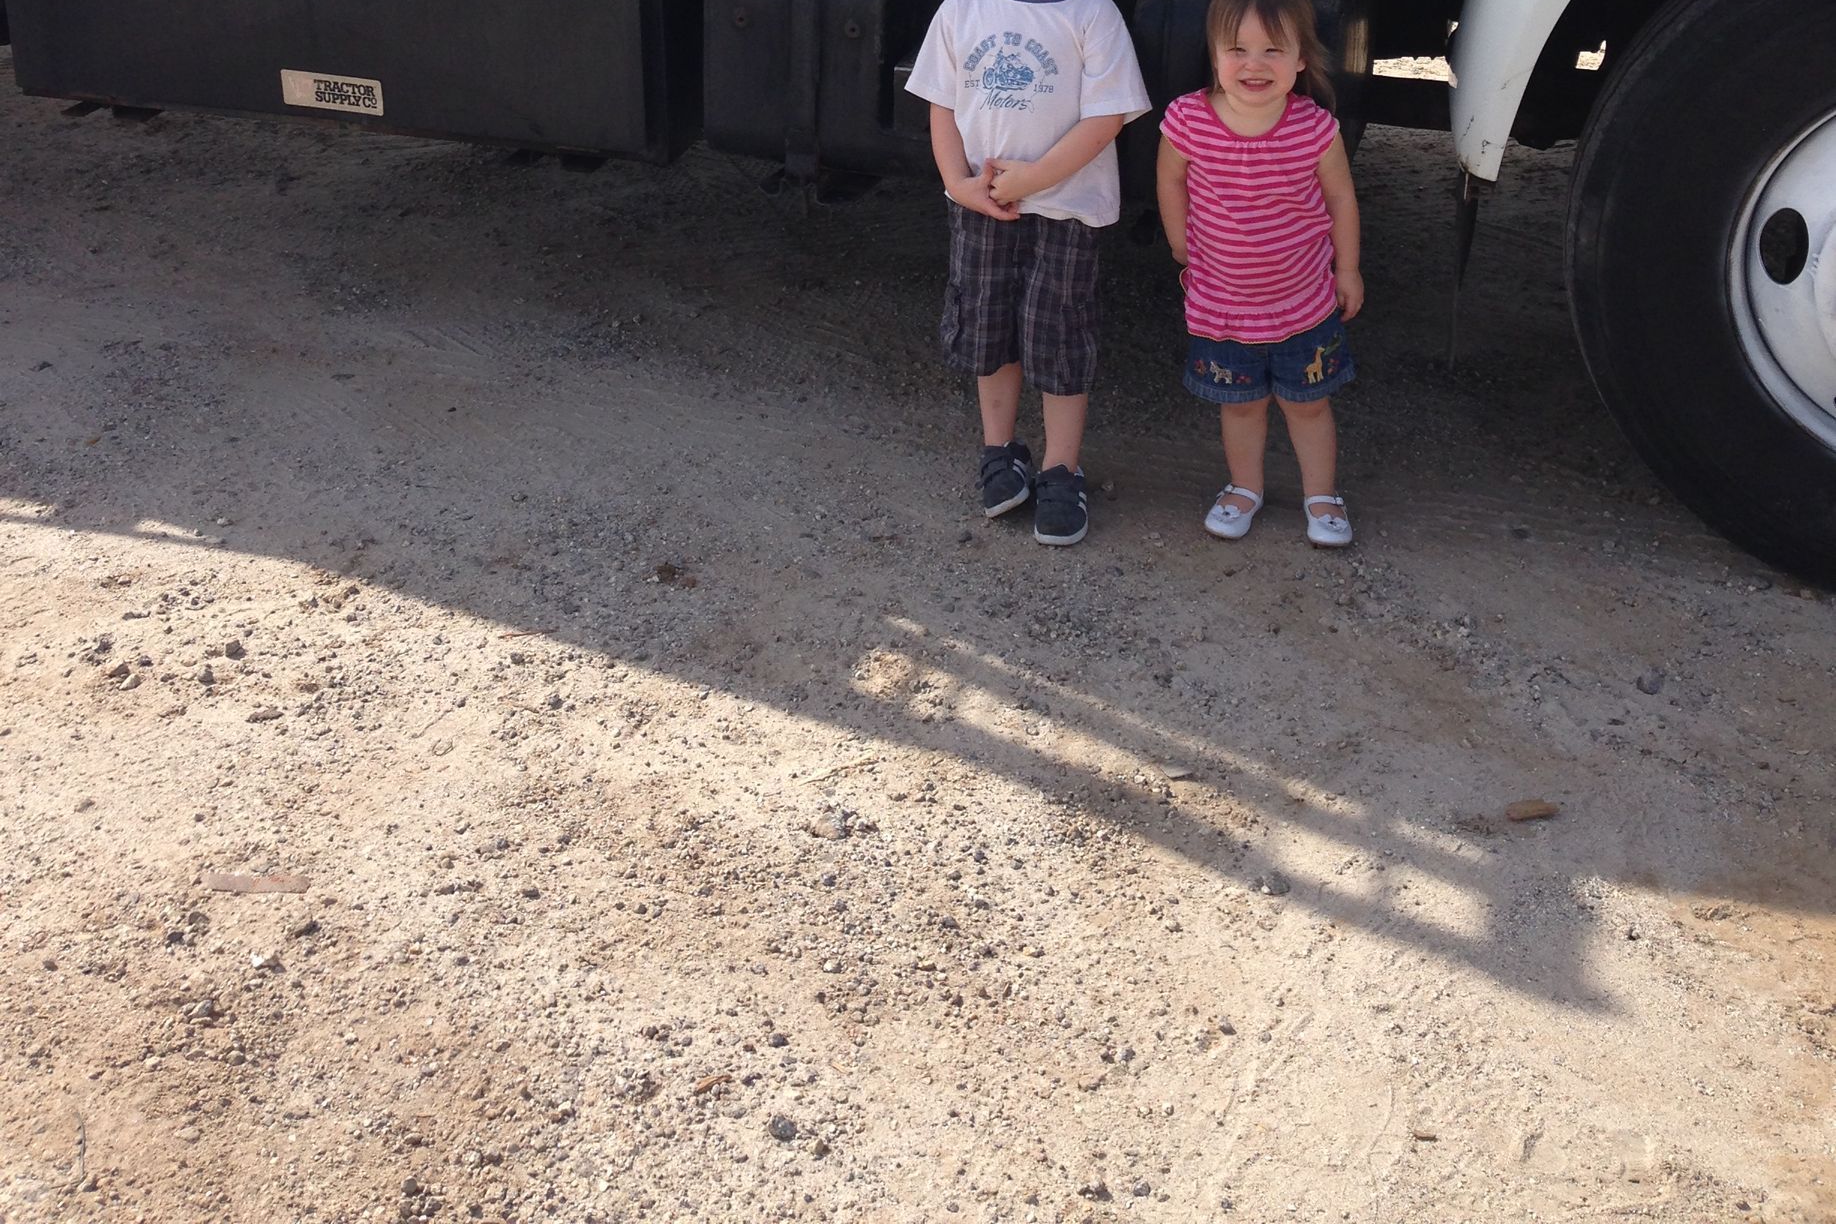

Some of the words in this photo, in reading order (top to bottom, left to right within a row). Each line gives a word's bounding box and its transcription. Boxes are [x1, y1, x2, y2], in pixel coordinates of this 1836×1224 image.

[1003, 31, 1022, 46] TO
[313, 79, 376, 98] TRACTOR
[964, 79, 980, 89] EST
[315, 91, 361, 107] SUPPLY
[980, 89, 1031, 111] Motors
